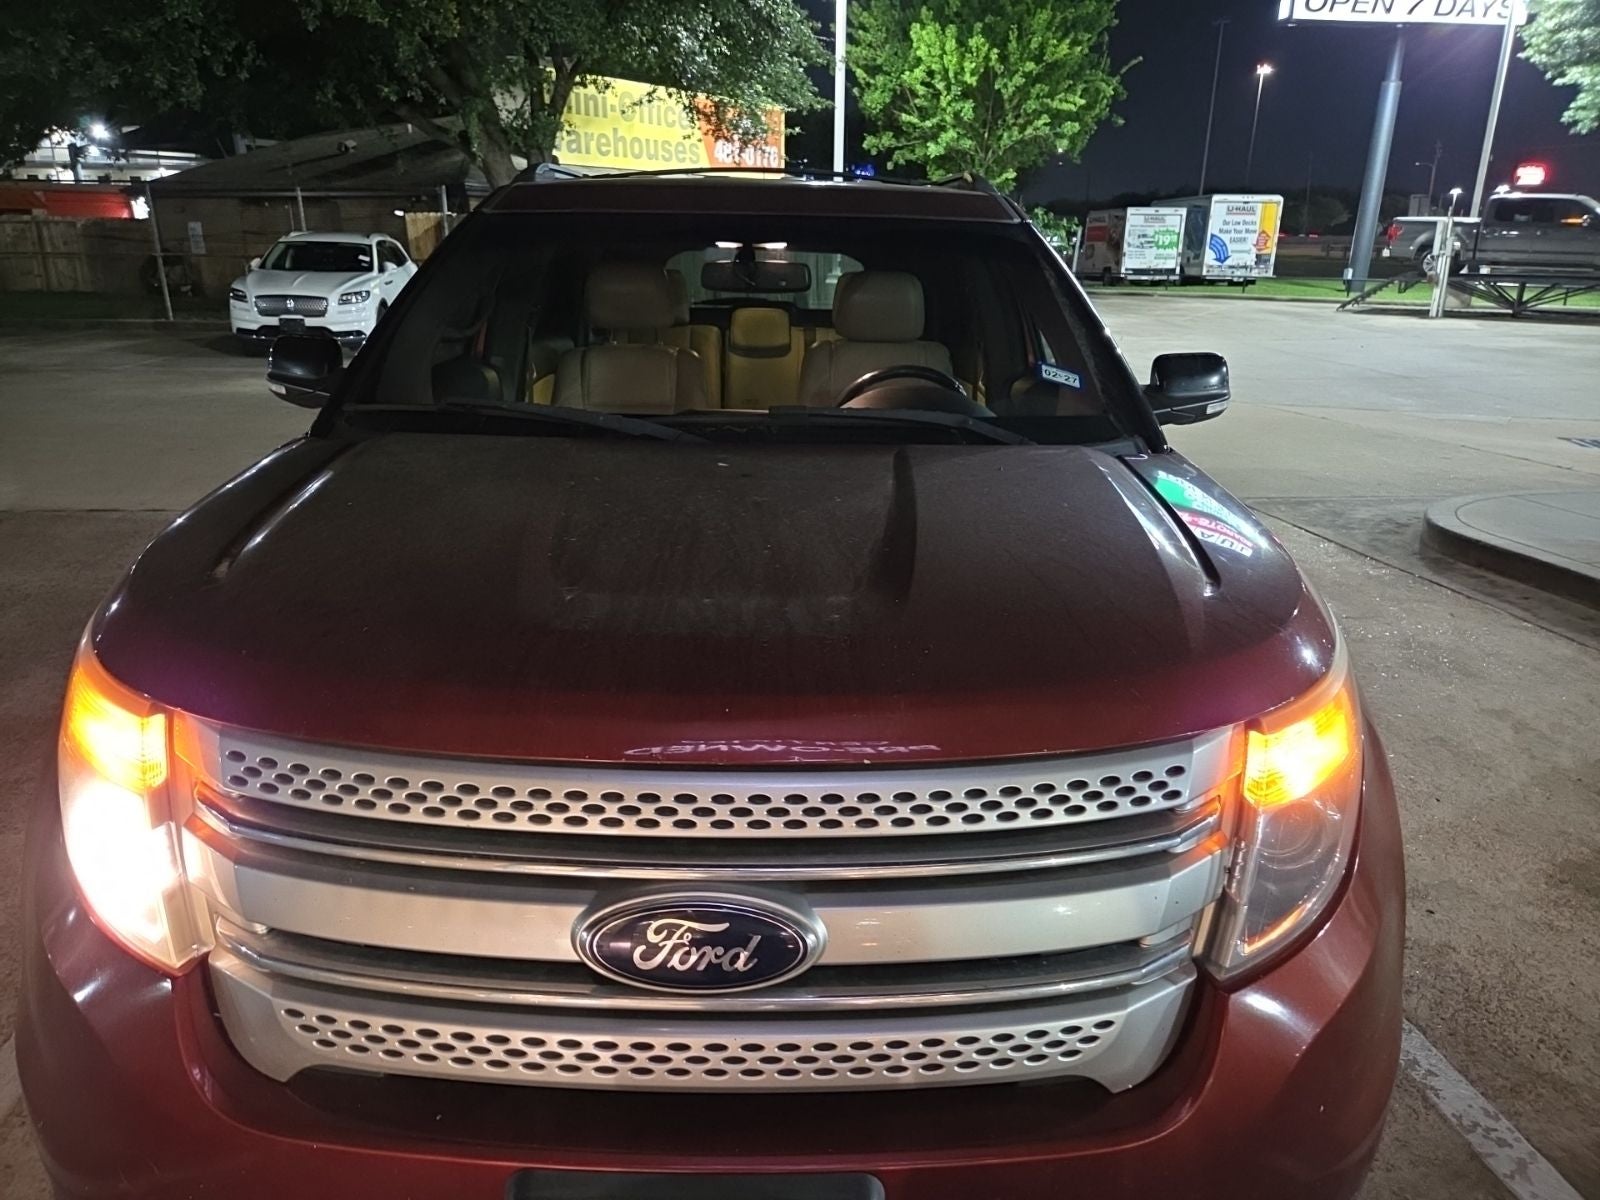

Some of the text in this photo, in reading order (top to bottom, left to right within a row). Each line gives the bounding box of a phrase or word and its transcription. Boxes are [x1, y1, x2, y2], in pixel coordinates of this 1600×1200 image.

[1304, 0, 1396, 14] OPEN
[1433, 0, 1510, 19] DAYS
[565, 87, 694, 130] ini-Office
[555, 127, 700, 164] arehouses
[1044, 369, 1078, 384] 02-27
[632, 918, 761, 972] Ford
